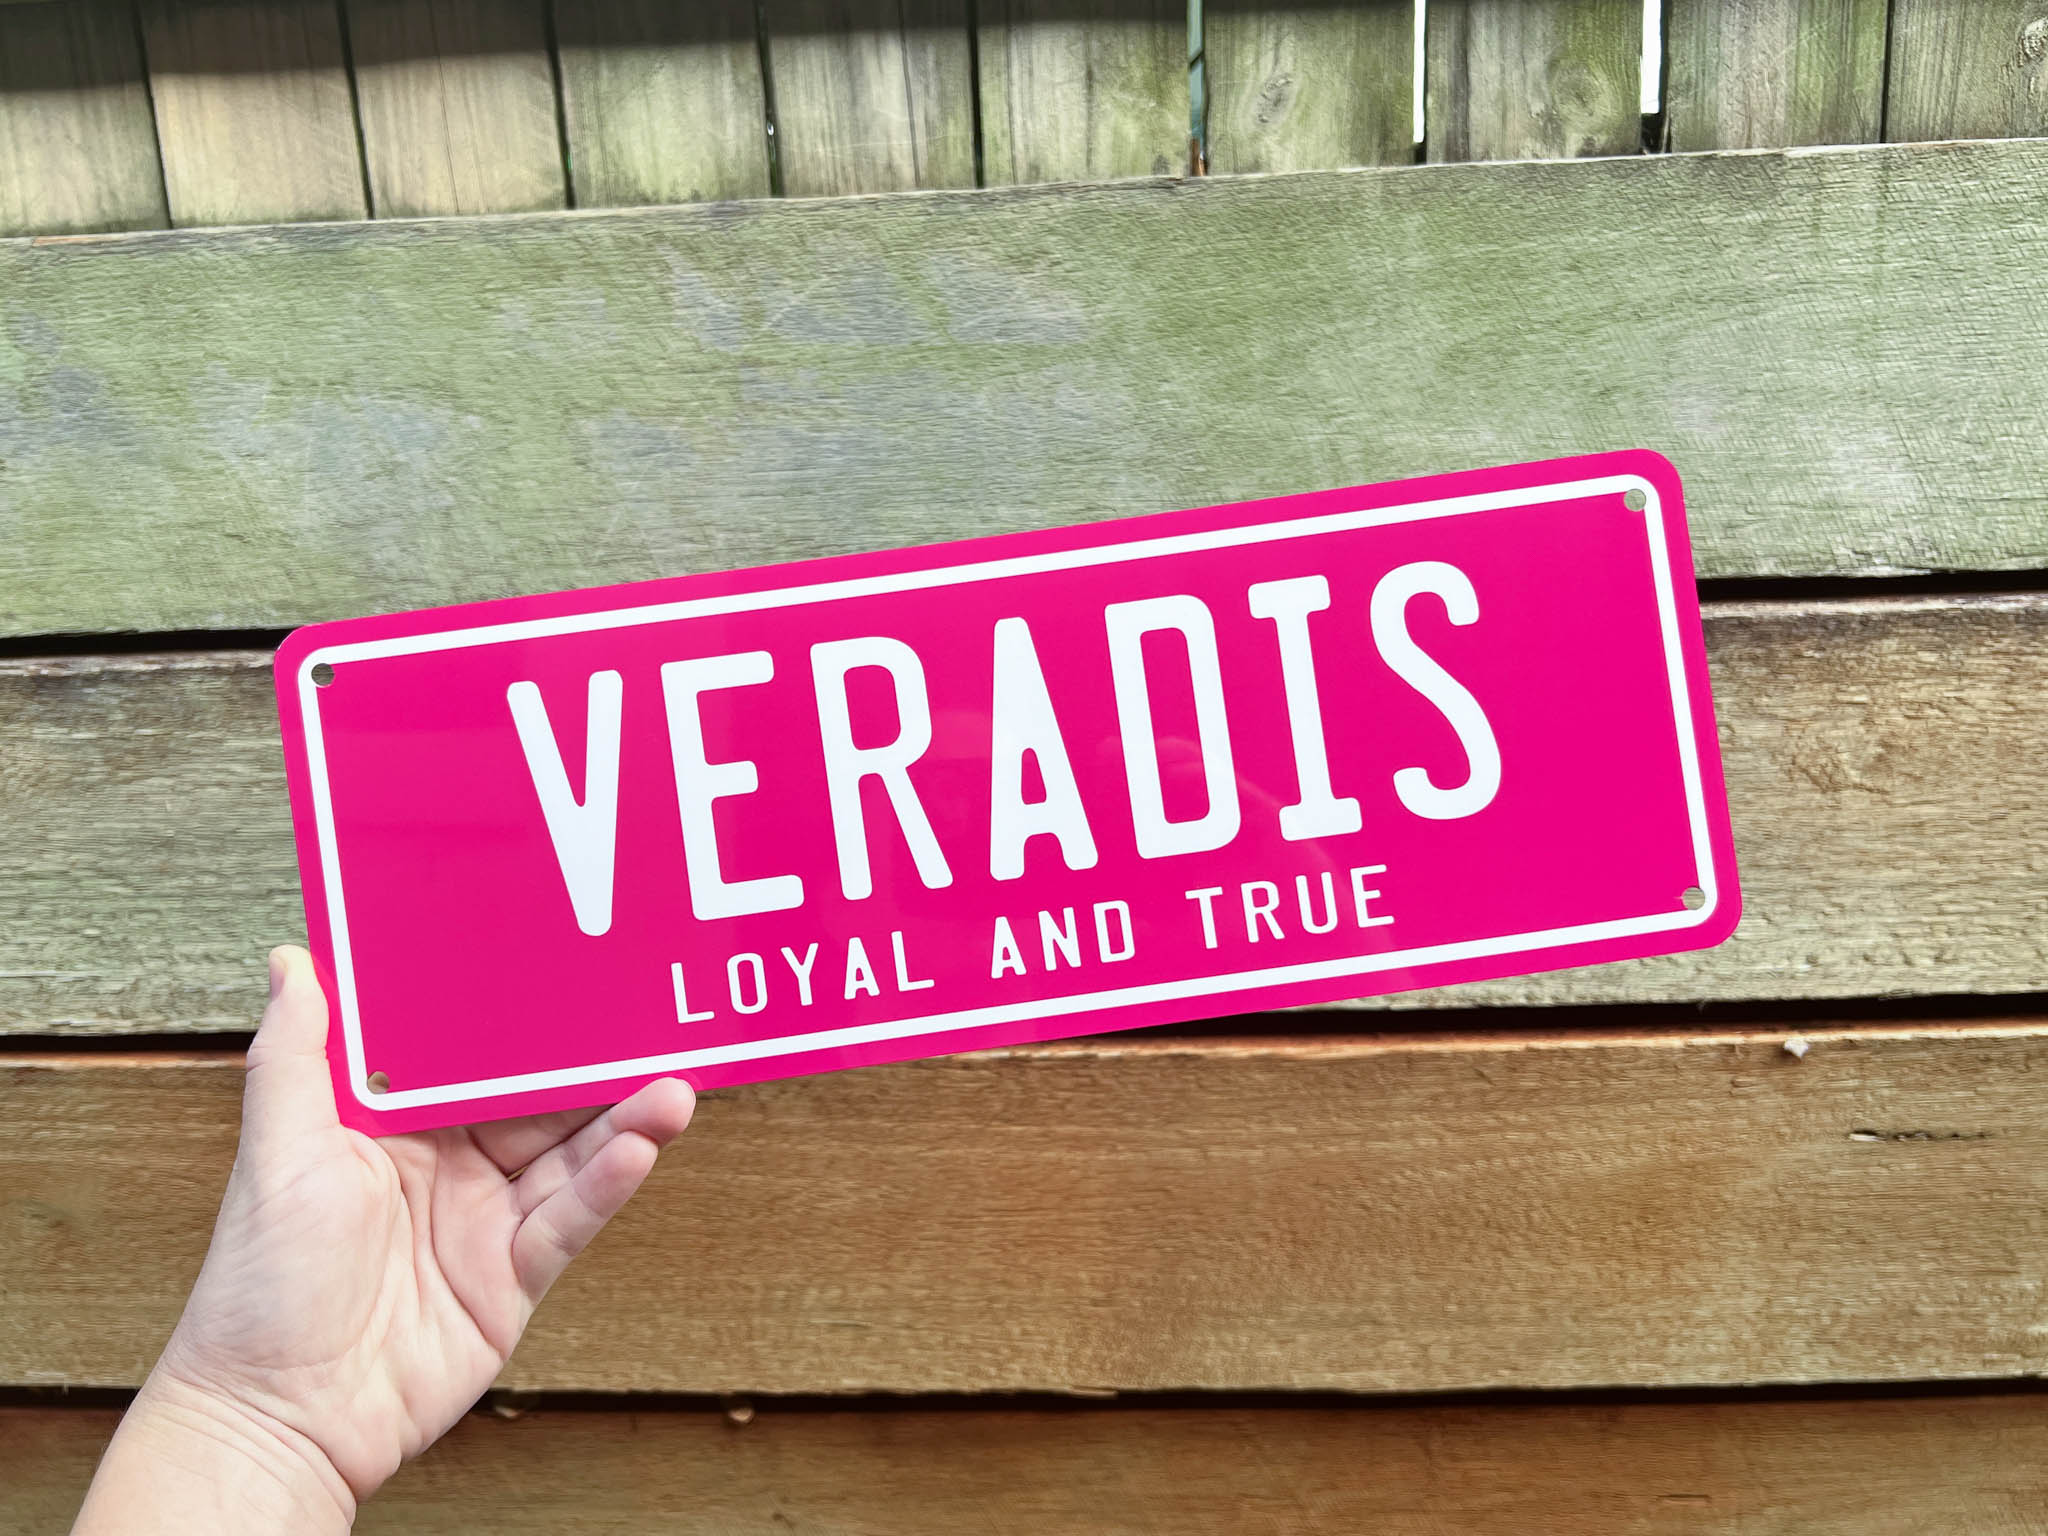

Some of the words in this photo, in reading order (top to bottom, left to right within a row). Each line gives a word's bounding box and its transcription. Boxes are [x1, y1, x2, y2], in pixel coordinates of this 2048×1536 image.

[506, 560, 1502, 937] VERADIS
[671, 930, 935, 1024] LOYAL
[991, 900, 1135, 979] AND
[1185, 864, 1395, 949] TRUE
